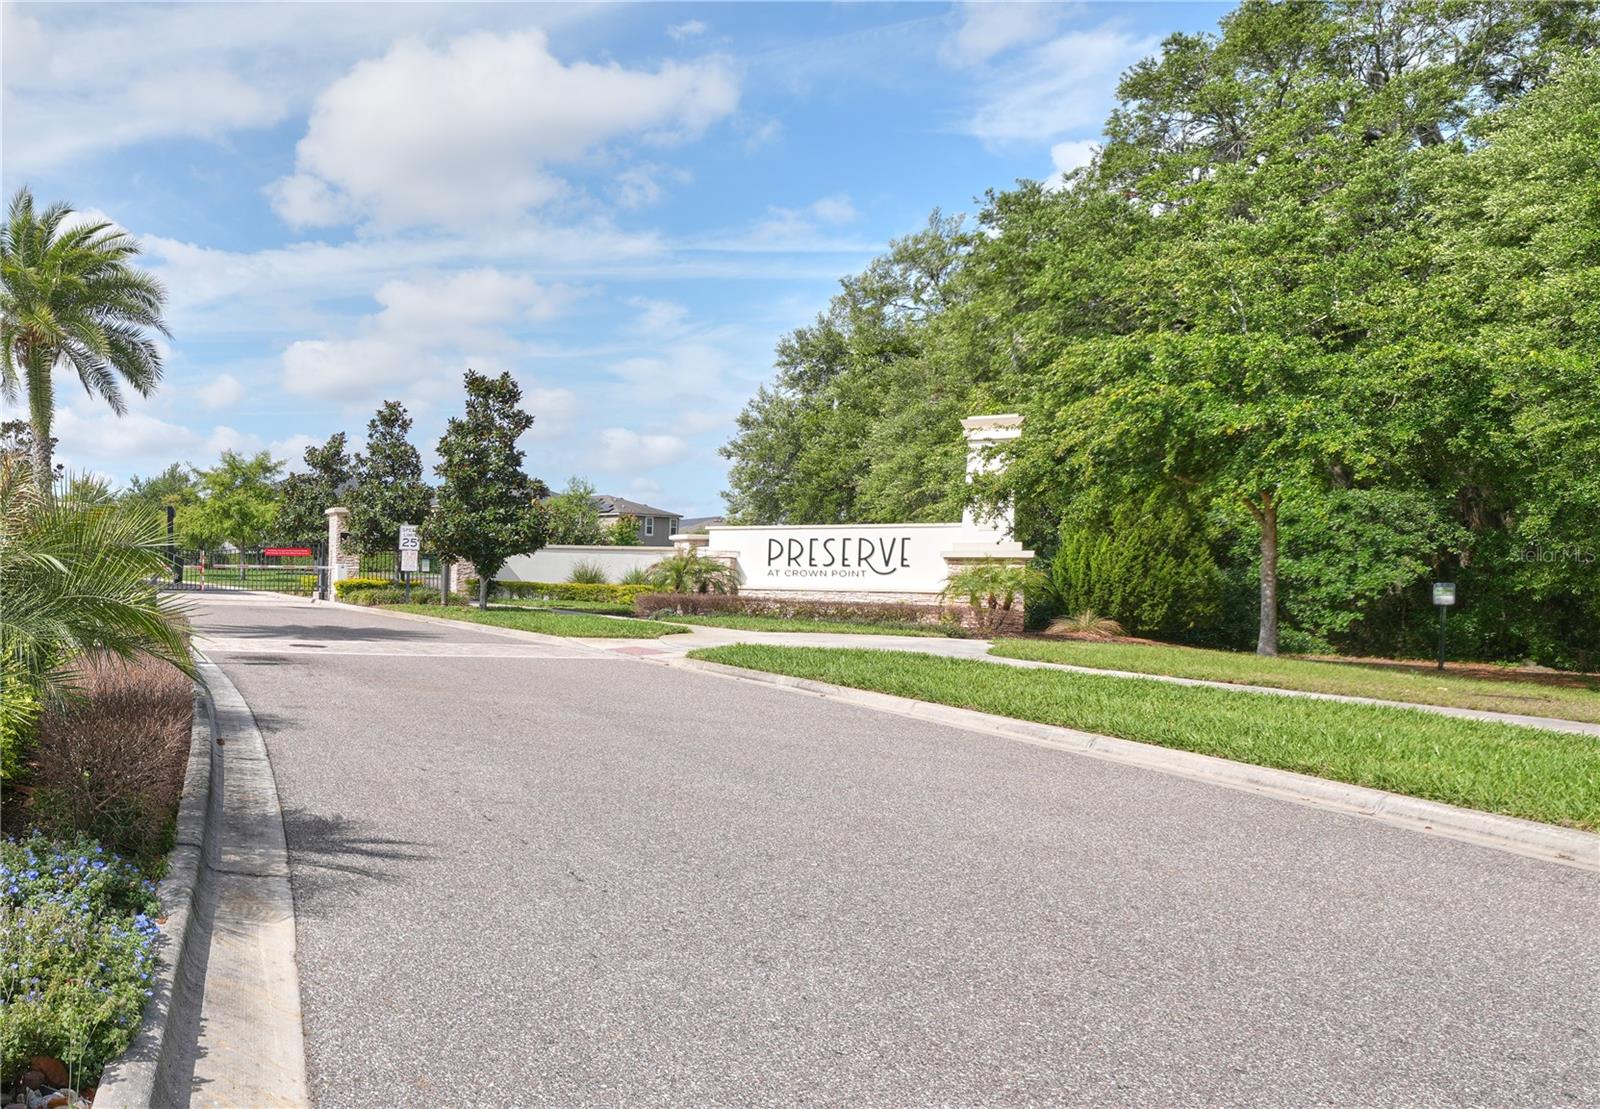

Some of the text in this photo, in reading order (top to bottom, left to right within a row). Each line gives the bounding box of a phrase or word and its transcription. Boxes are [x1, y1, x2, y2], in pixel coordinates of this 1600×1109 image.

[402, 538, 418, 547] 25
[767, 537, 911, 575] PRESERVE
[767, 569, 867, 578] AT CROWN POINT
